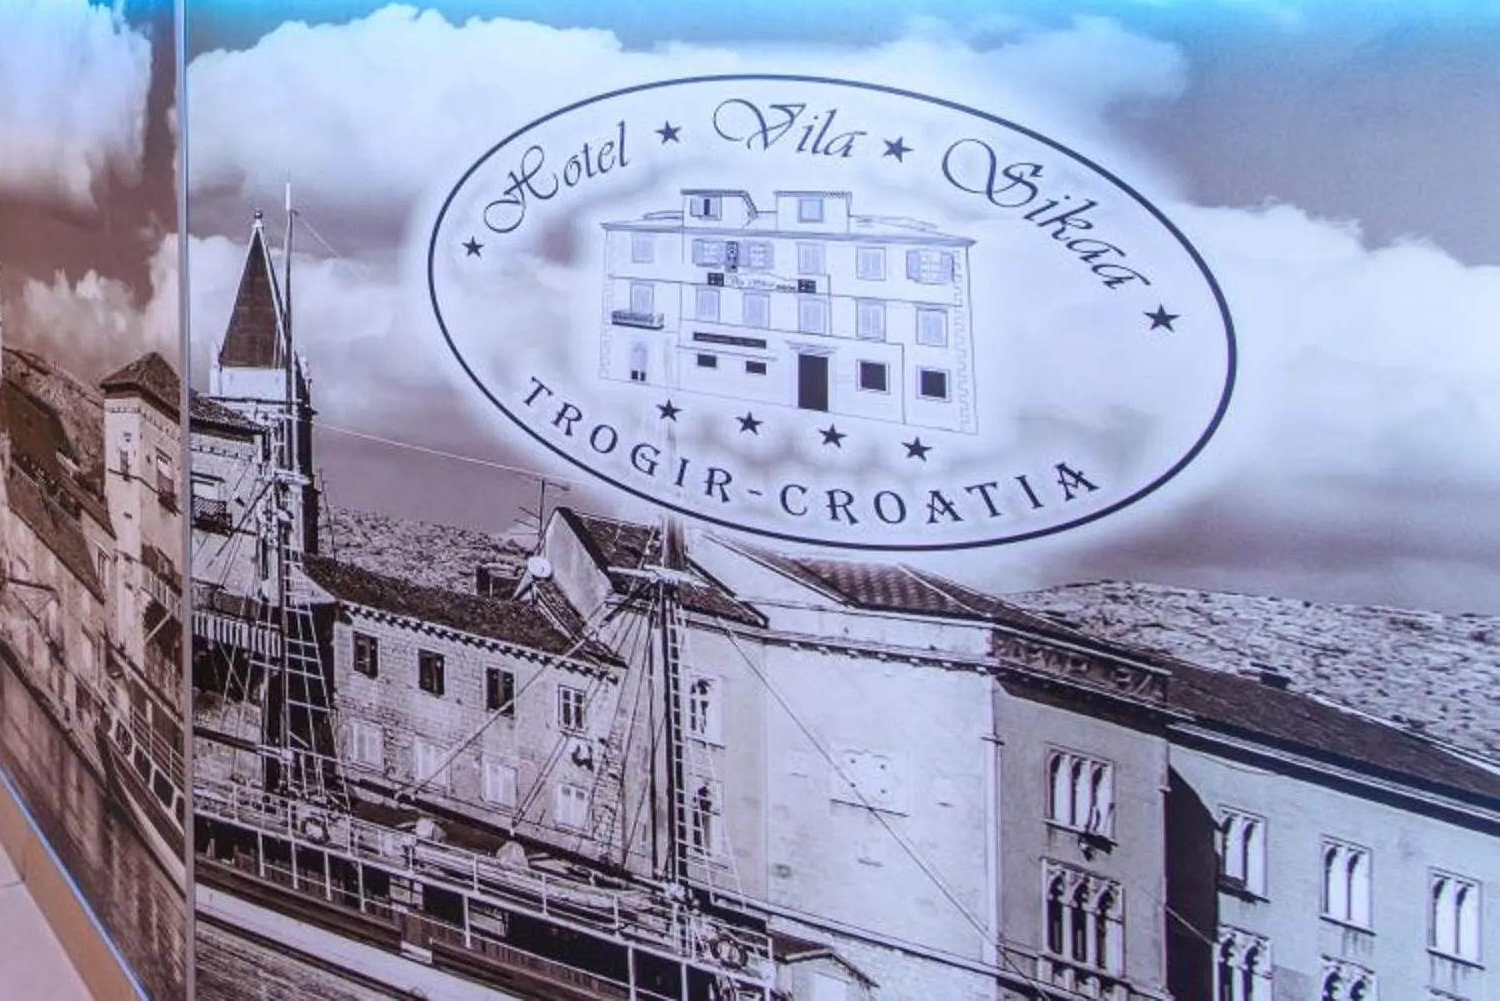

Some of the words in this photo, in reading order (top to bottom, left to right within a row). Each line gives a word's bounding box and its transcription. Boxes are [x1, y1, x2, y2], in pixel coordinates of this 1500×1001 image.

[483, 119, 629, 234] Hotel
[712, 98, 868, 158] Vila
[941, 137, 1152, 290] Sikaa
